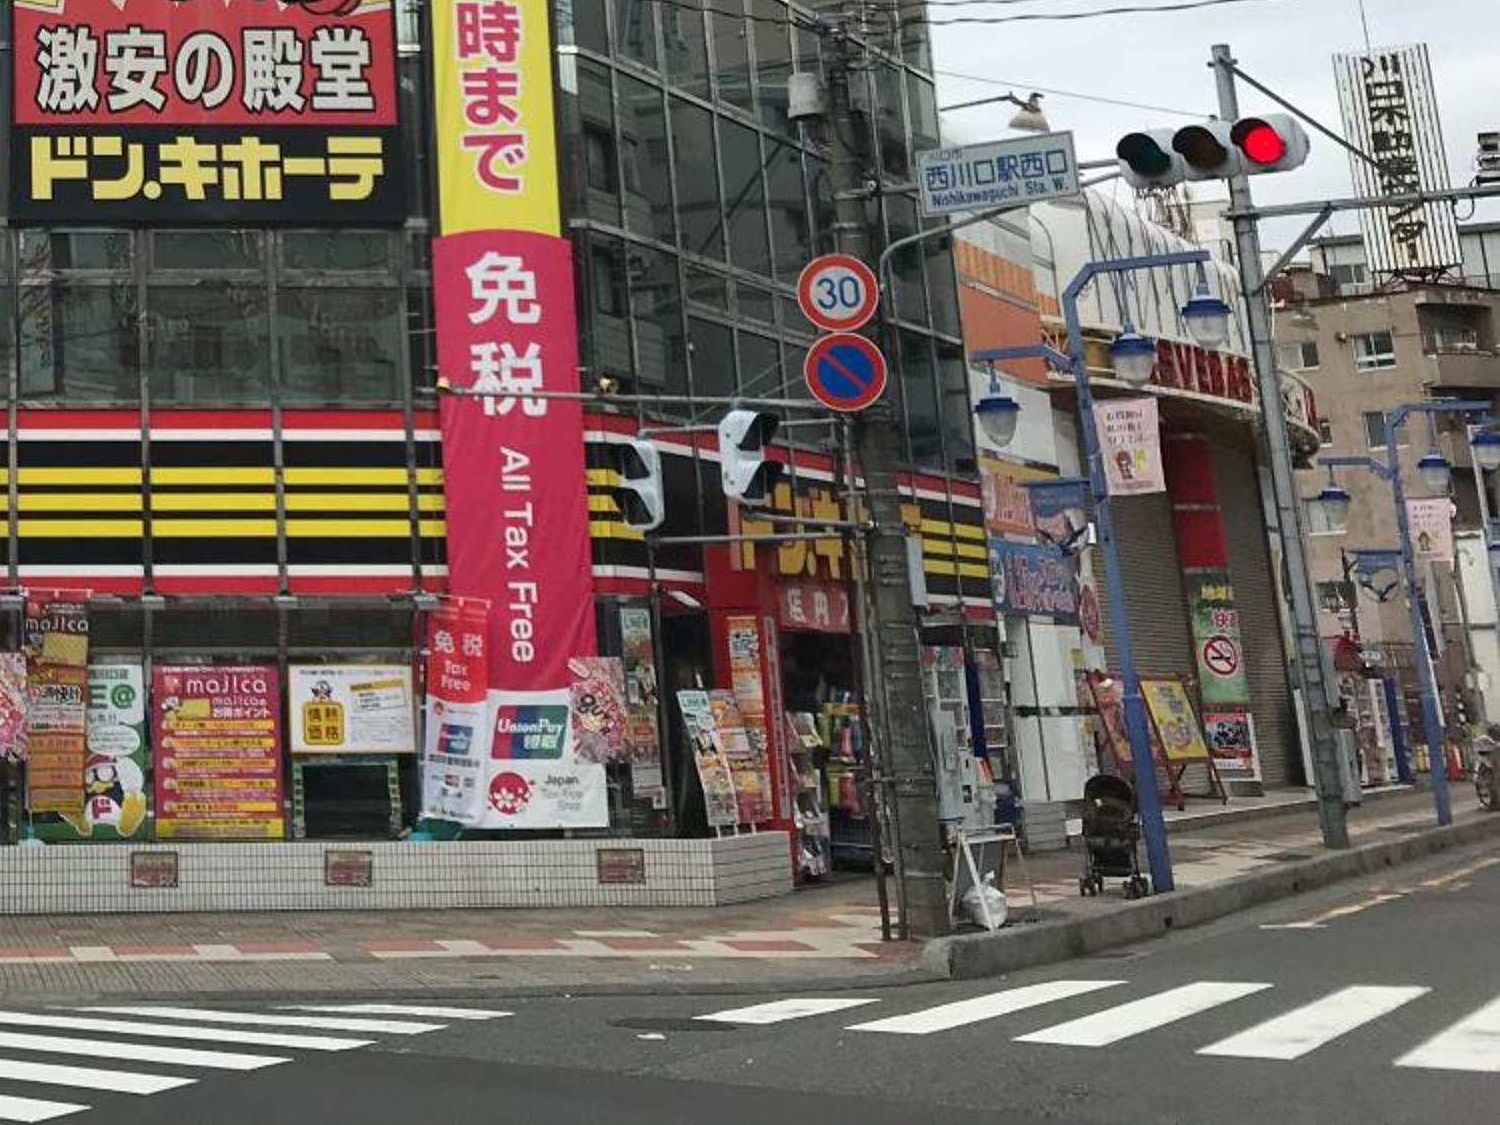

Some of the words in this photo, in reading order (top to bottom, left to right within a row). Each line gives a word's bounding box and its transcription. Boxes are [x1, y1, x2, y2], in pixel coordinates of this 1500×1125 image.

[36, 26, 375, 112] 激安の殿堂
[925, 149, 1068, 192] 西川口駅西口
[932, 180, 1019, 208] Nishikawaguchi
[1052, 176, 1070, 193] W.
[817, 276, 860, 309] 30
[465, 251, 548, 417] 免税
[501, 446, 531, 491] All
[504, 503, 534, 569] Tax
[25, 617, 89, 633] majica
[507, 581, 538, 663] Free
[441, 675, 471, 692] Free
[444, 659, 468, 675] Tax
[187, 676, 267, 694] majica
[497, 718, 564, 736] UnionPay
